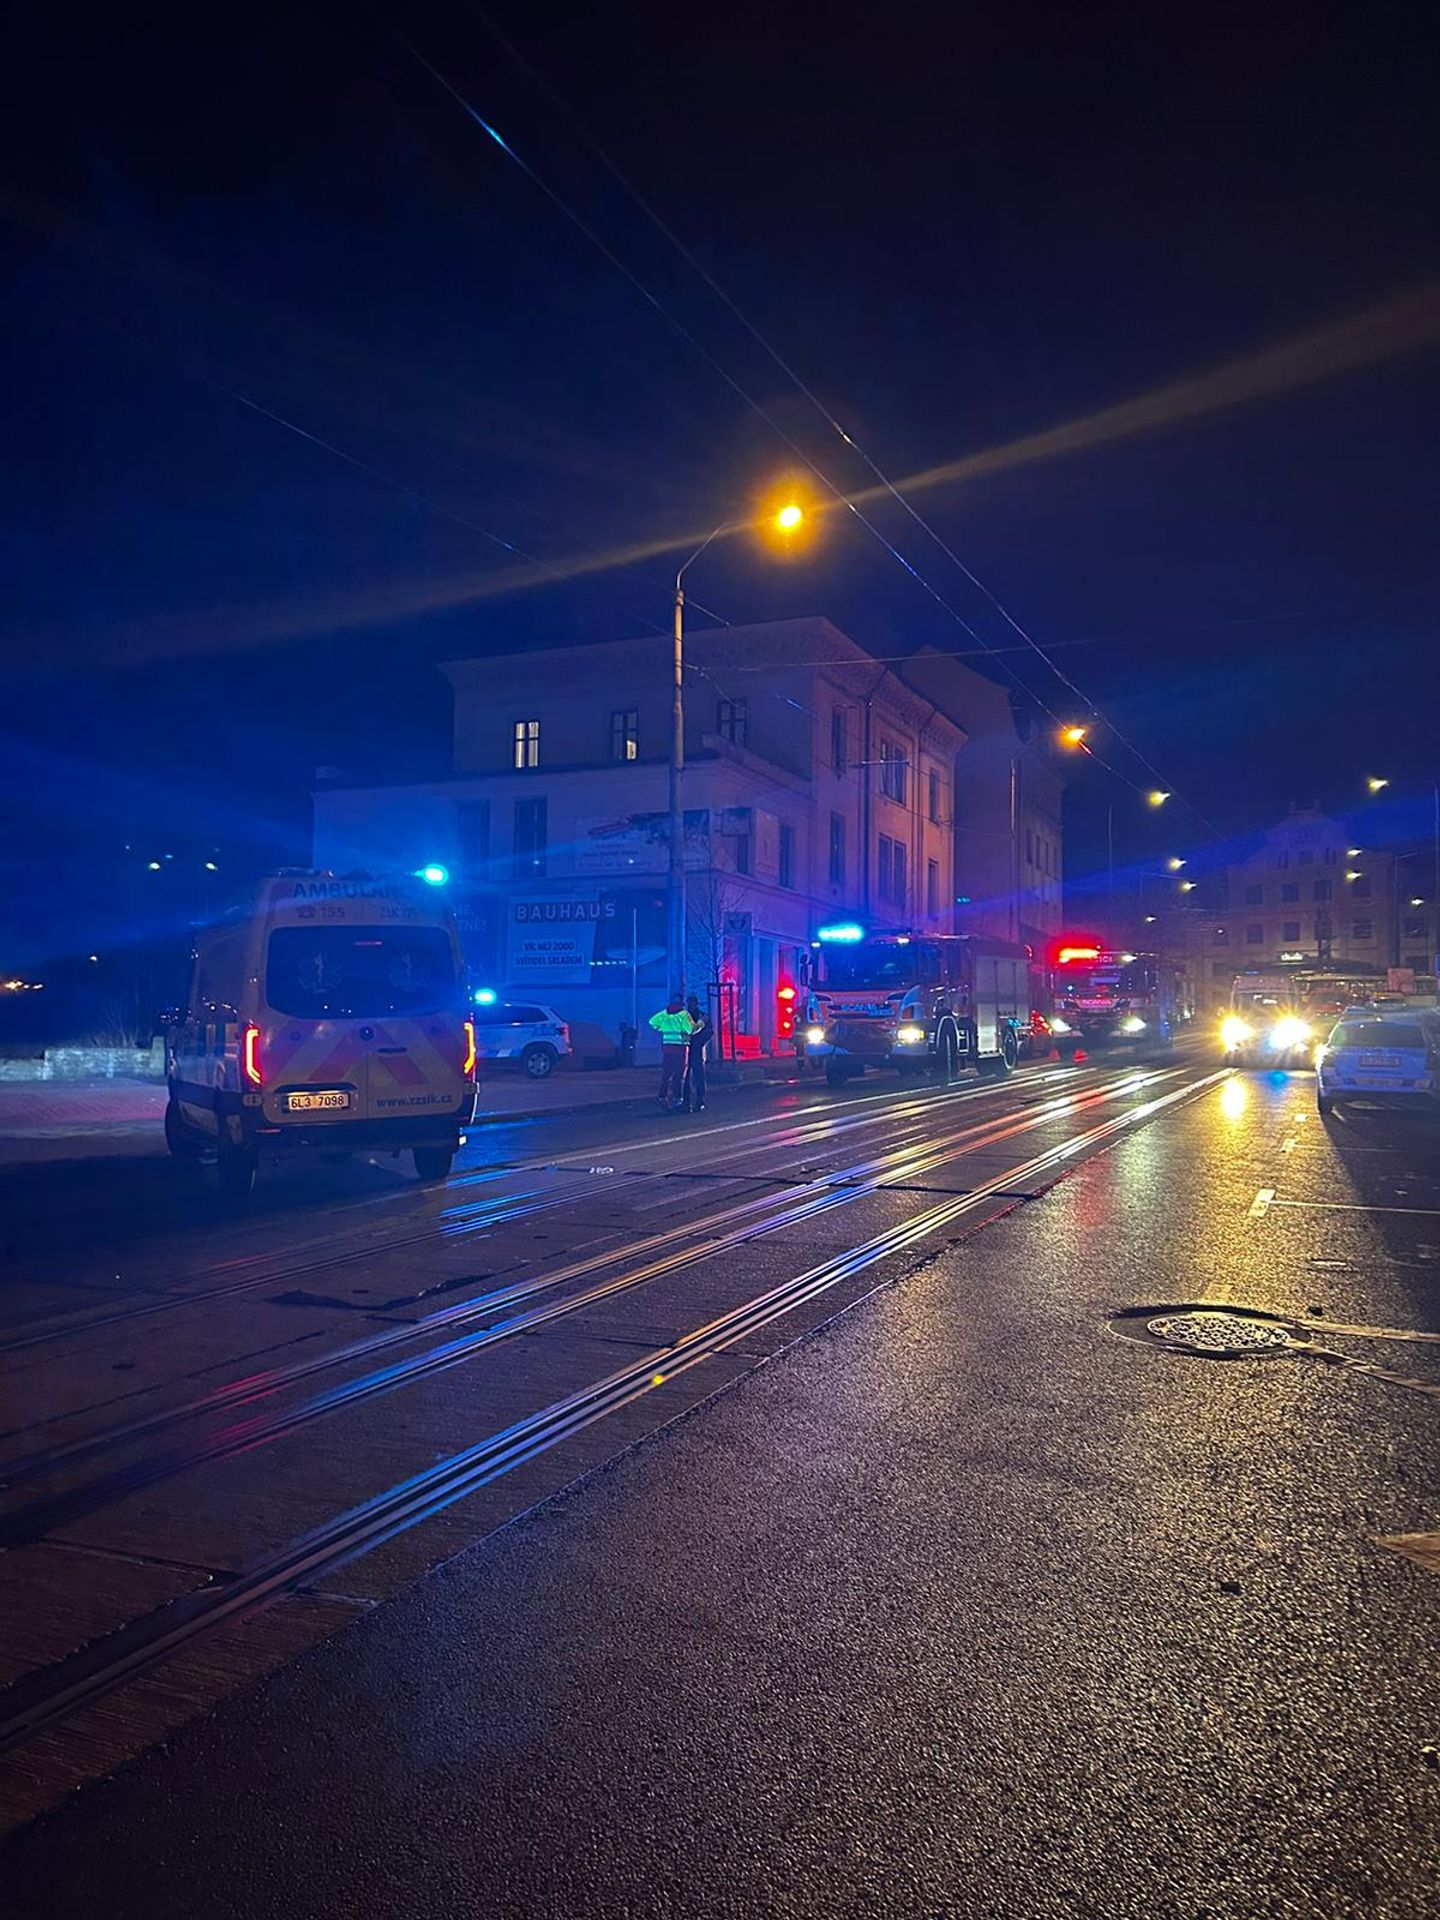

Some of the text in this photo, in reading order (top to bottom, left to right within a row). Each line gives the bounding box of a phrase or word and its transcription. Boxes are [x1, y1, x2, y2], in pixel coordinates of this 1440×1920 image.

[517, 902, 615, 920] BAUHAUS
[553, 941, 575, 951] 2000
[291, 1095, 345, 1109] 6L3 7098
